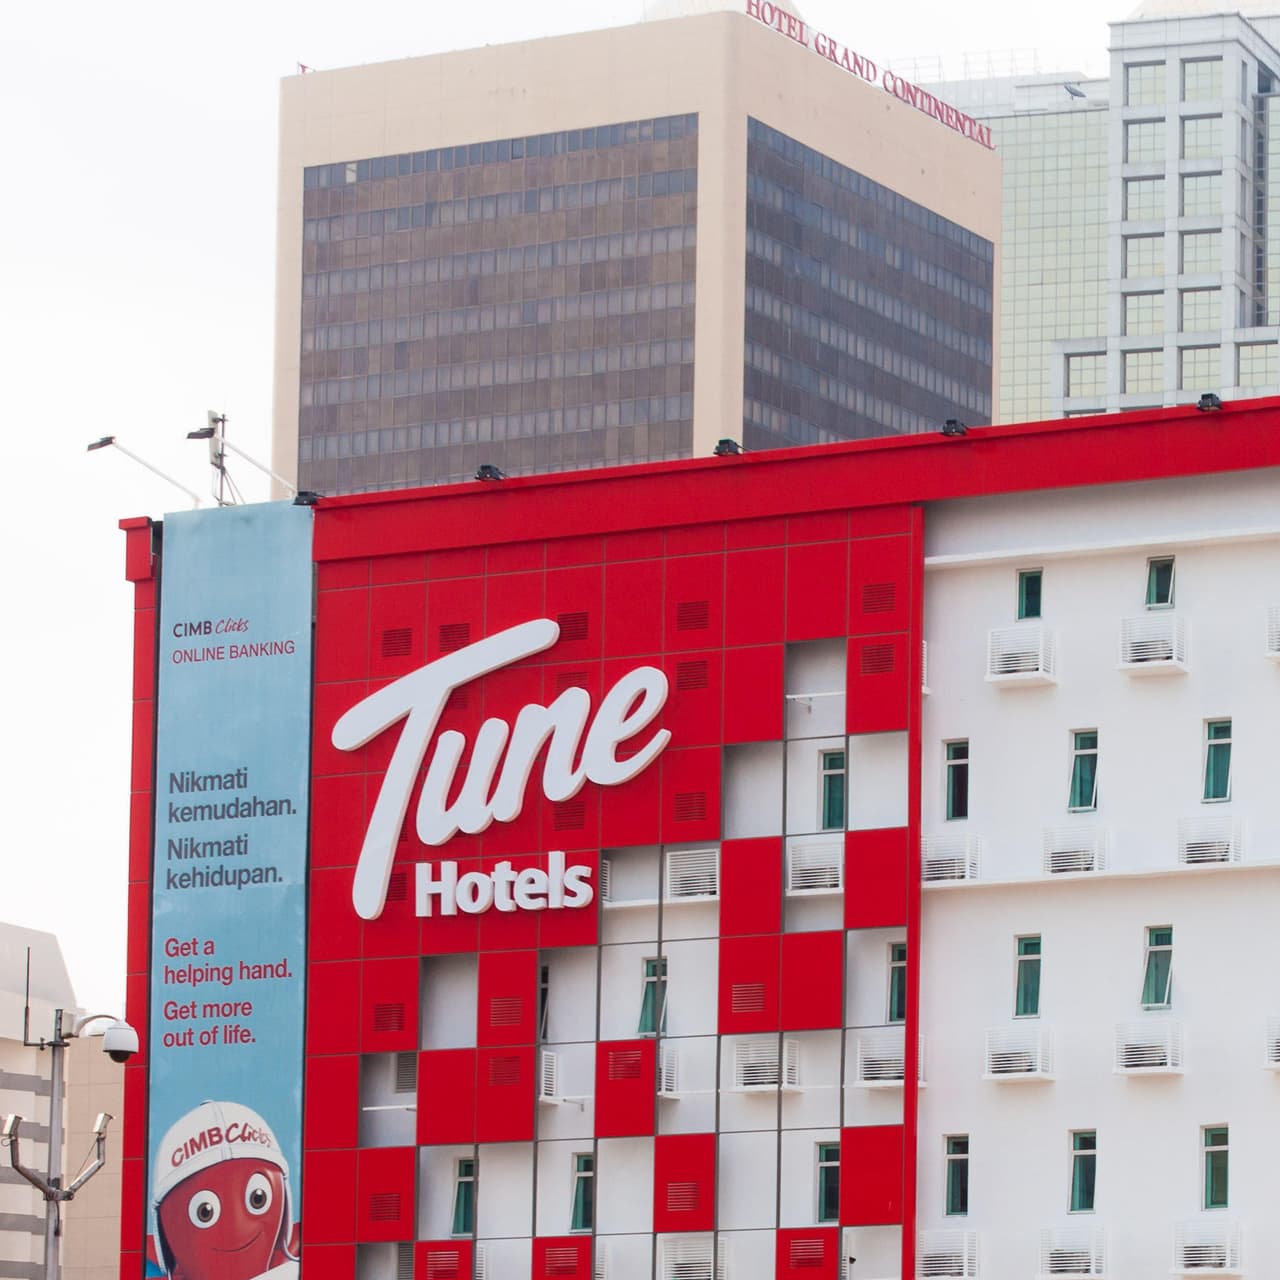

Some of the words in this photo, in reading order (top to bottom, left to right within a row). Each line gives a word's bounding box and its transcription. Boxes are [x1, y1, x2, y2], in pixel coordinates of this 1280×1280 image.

[746, 0, 809, 48] HOTEL
[815, 31, 877, 83] GRAND
[883, 70, 996, 150] CONTINENTAL
[173, 620, 213, 638] CIMB
[215, 618, 250, 635] Clicks
[172, 645, 225, 664] ONLINE
[229, 640, 295, 660] BANKING
[169, 767, 248, 794] Nikmati
[332, 618, 672, 920] Tune
[168, 796, 297, 824] kemudahan.
[167, 833, 249, 860] Nikmati
[166, 864, 283, 890] kehidupan.
[415, 851, 593, 917] Hotels
[165, 937, 198, 957] Get
[203, 942, 215, 956] a
[164, 961, 233, 986] helping
[239, 957, 292, 980] hand.
[163, 1001, 197, 1021] Get
[202, 1001, 252, 1018] more
[163, 1028, 195, 1047] out
[199, 1025, 219, 1045] of
[223, 1022, 256, 1044] life.
[171, 1126, 223, 1167] CIMB
